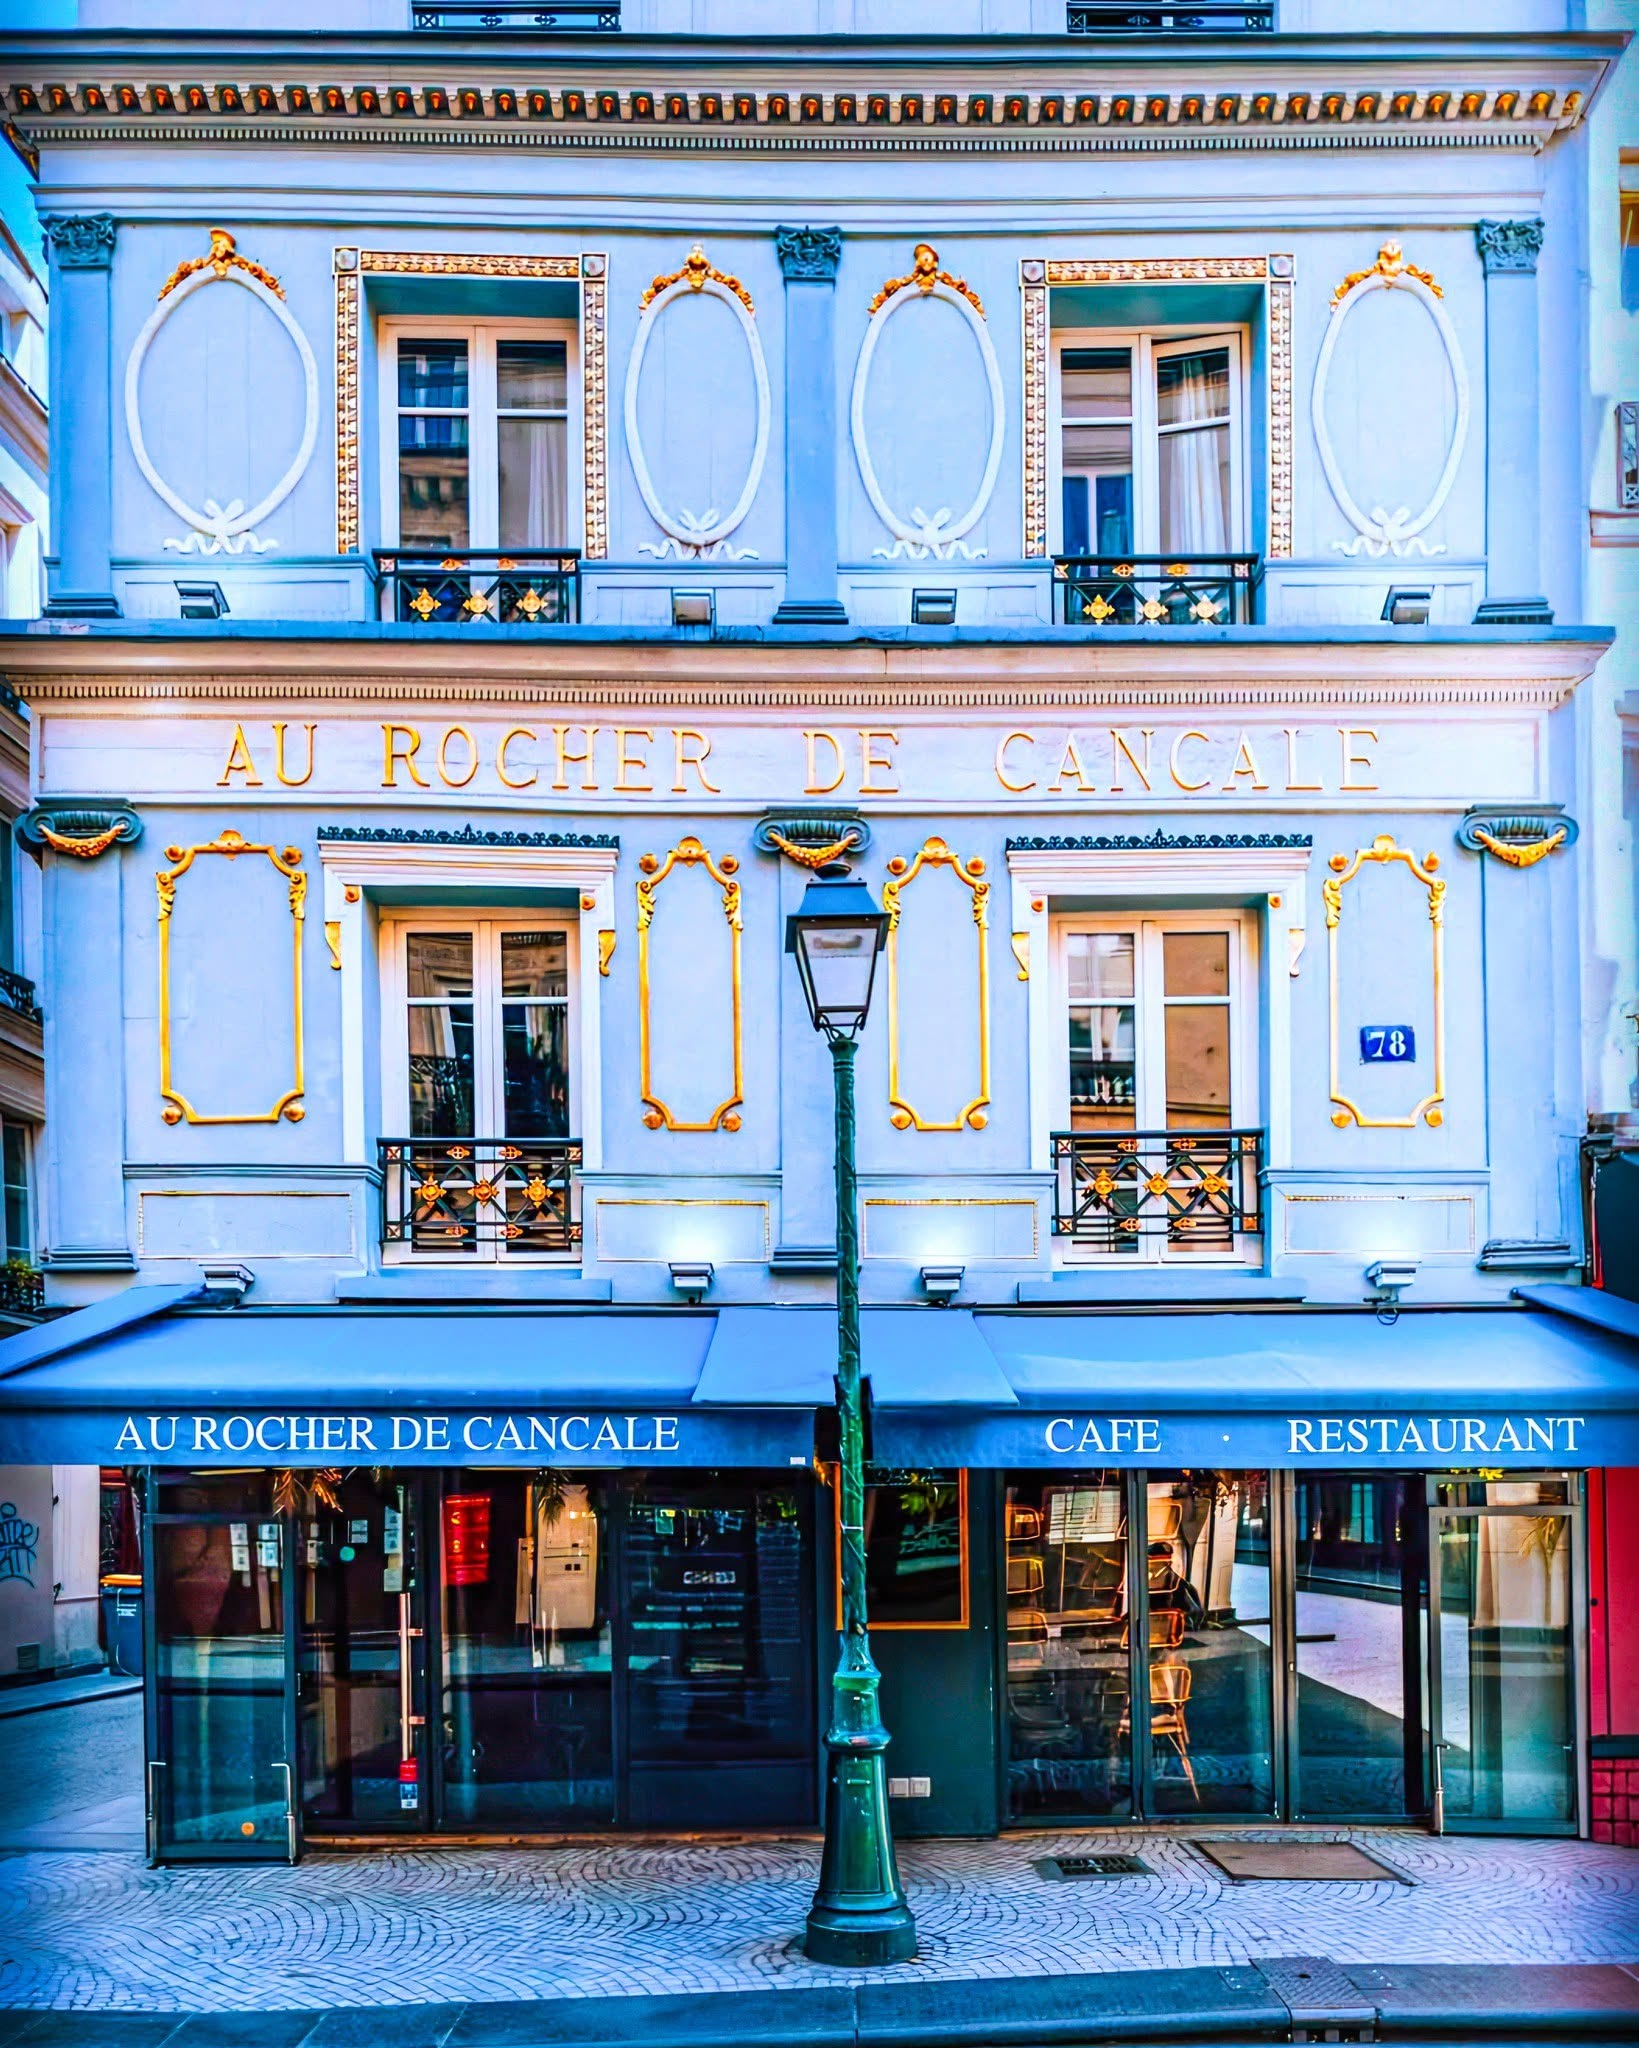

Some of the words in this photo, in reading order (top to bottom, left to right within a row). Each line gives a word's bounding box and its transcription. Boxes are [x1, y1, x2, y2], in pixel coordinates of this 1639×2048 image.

[216, 722, 318, 787] AU
[380, 723, 722, 795] ROCHER
[803, 728, 900, 795] DE
[994, 726, 1380, 793] CANCALE
[1367, 1030, 1407, 1058] 78
[114, 1415, 178, 1451] AU
[191, 1415, 378, 1452] ROCHER
[391, 1416, 451, 1451] DE
[462, 1415, 681, 1452] CANCALE
[1044, 1418, 1162, 1454] CAFE
[1286, 1416, 1586, 1454] RESTAURANT
